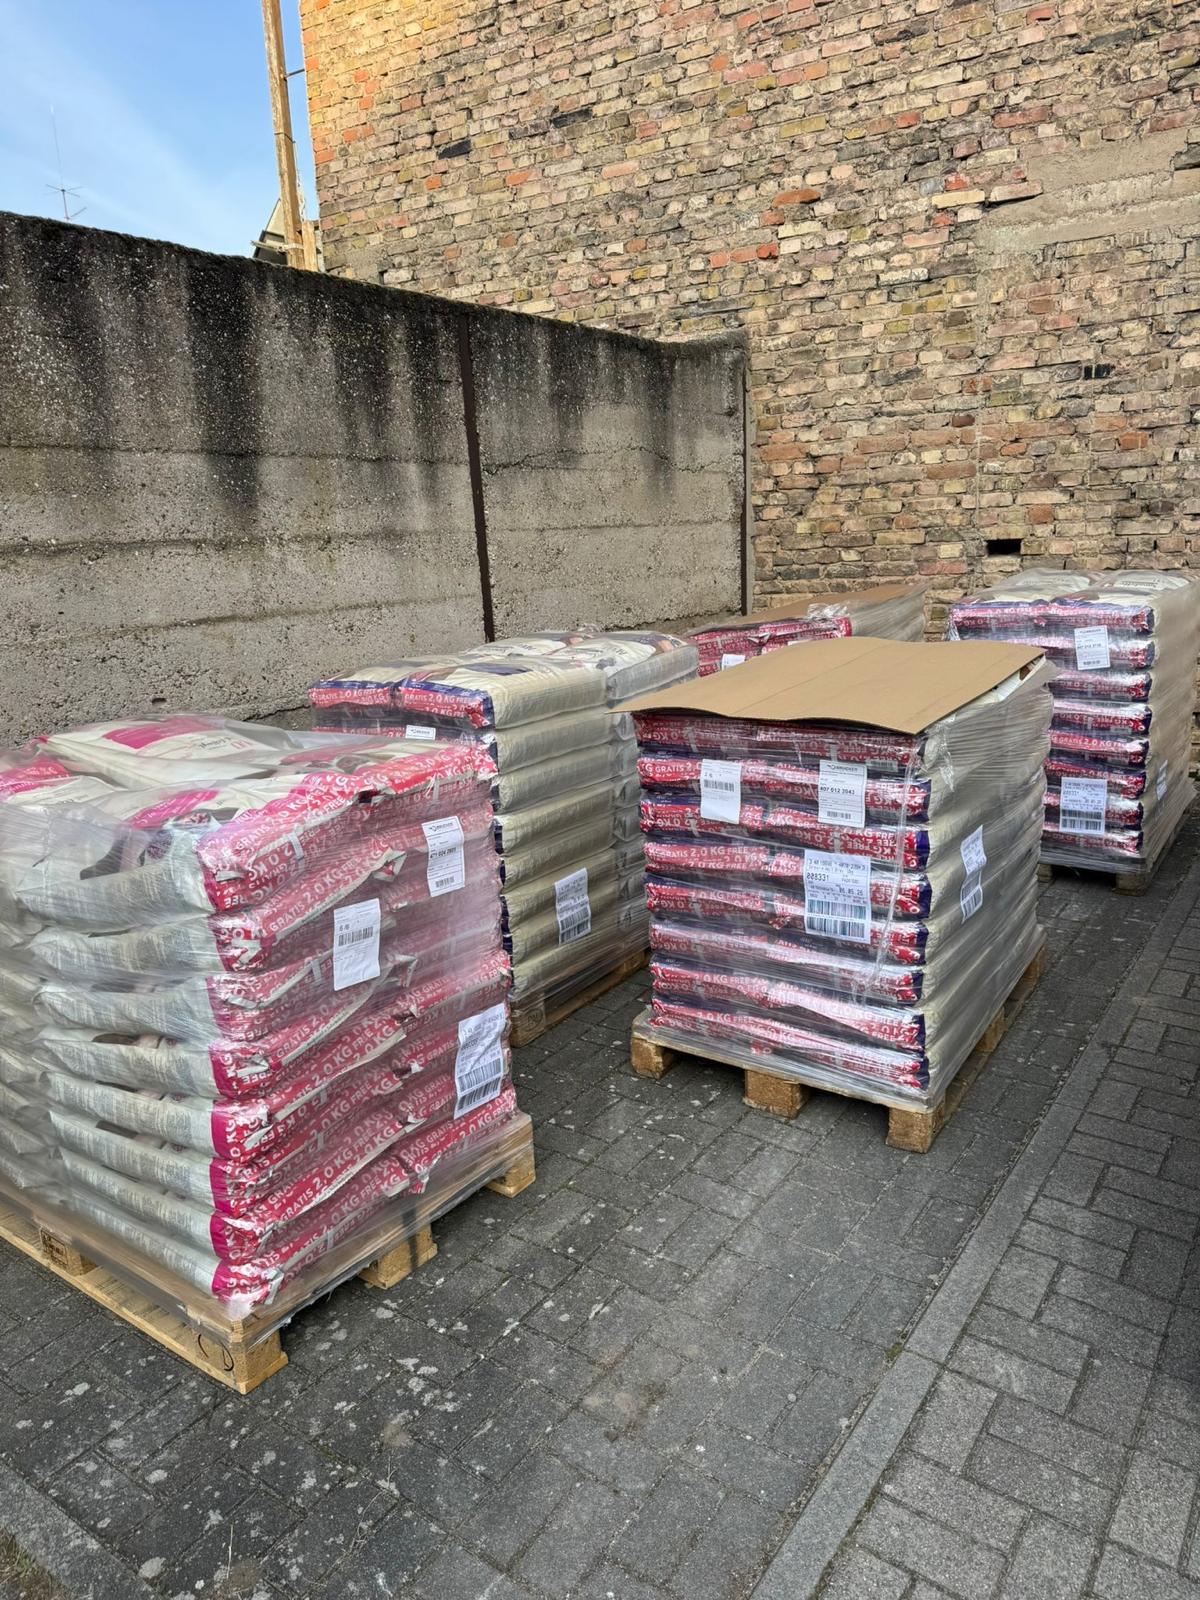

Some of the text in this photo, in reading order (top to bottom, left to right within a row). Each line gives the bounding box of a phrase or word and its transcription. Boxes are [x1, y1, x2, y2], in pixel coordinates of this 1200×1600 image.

[655, 764, 684, 772] GRATIS
[235, 823, 270, 850] GRATIS
[710, 847, 725, 856] KG
[727, 847, 748, 855] FREE
[269, 901, 305, 932] GRATIS
[323, 869, 342, 887] KG
[713, 974, 728, 983] KG
[717, 1013, 731, 1021] KG
[276, 1024, 311, 1058] GRATIS
[373, 1024, 394, 1044] KG
[333, 1044, 353, 1067] KG
[331, 1100, 351, 1119] KG
[351, 1082, 372, 1101] FREE
[225, 1119, 238, 1144] KG
[478, 1113, 493, 1128] KG
[372, 1125, 396, 1146] KG
[279, 1190, 314, 1222] GRATIS
[334, 1146, 354, 1166] KG
[352, 1131, 374, 1153] FREE
[381, 1175, 401, 1193] KG
[340, 1193, 360, 1214] KG
[360, 1175, 382, 1197] FREE
